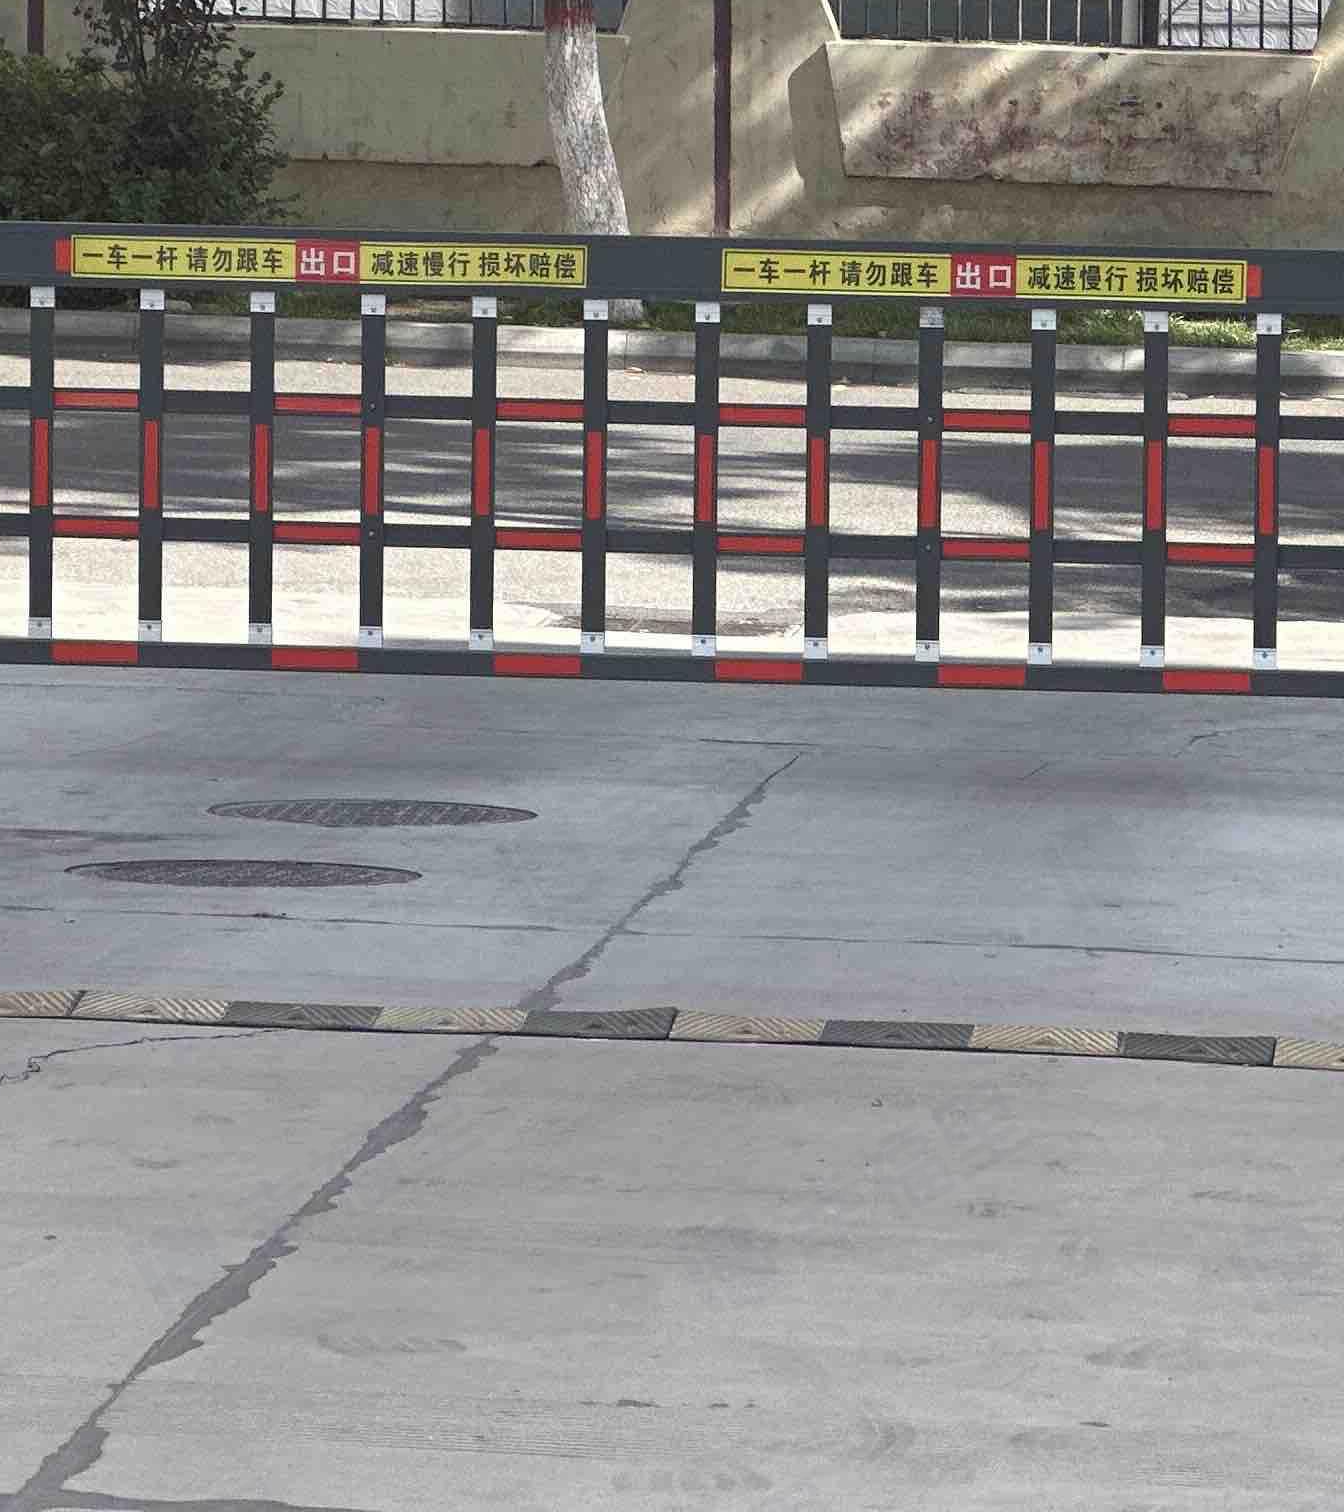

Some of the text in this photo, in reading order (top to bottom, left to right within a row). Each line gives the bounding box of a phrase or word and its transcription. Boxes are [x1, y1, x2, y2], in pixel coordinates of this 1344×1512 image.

[82, 243, 577, 281] 一车一杆 请勿跟车 出口 减速慢行 损坏赔偿
[733, 258, 1235, 295] 一车一杆 请勿跟车 出口 减速慢行 损坏赔偿
